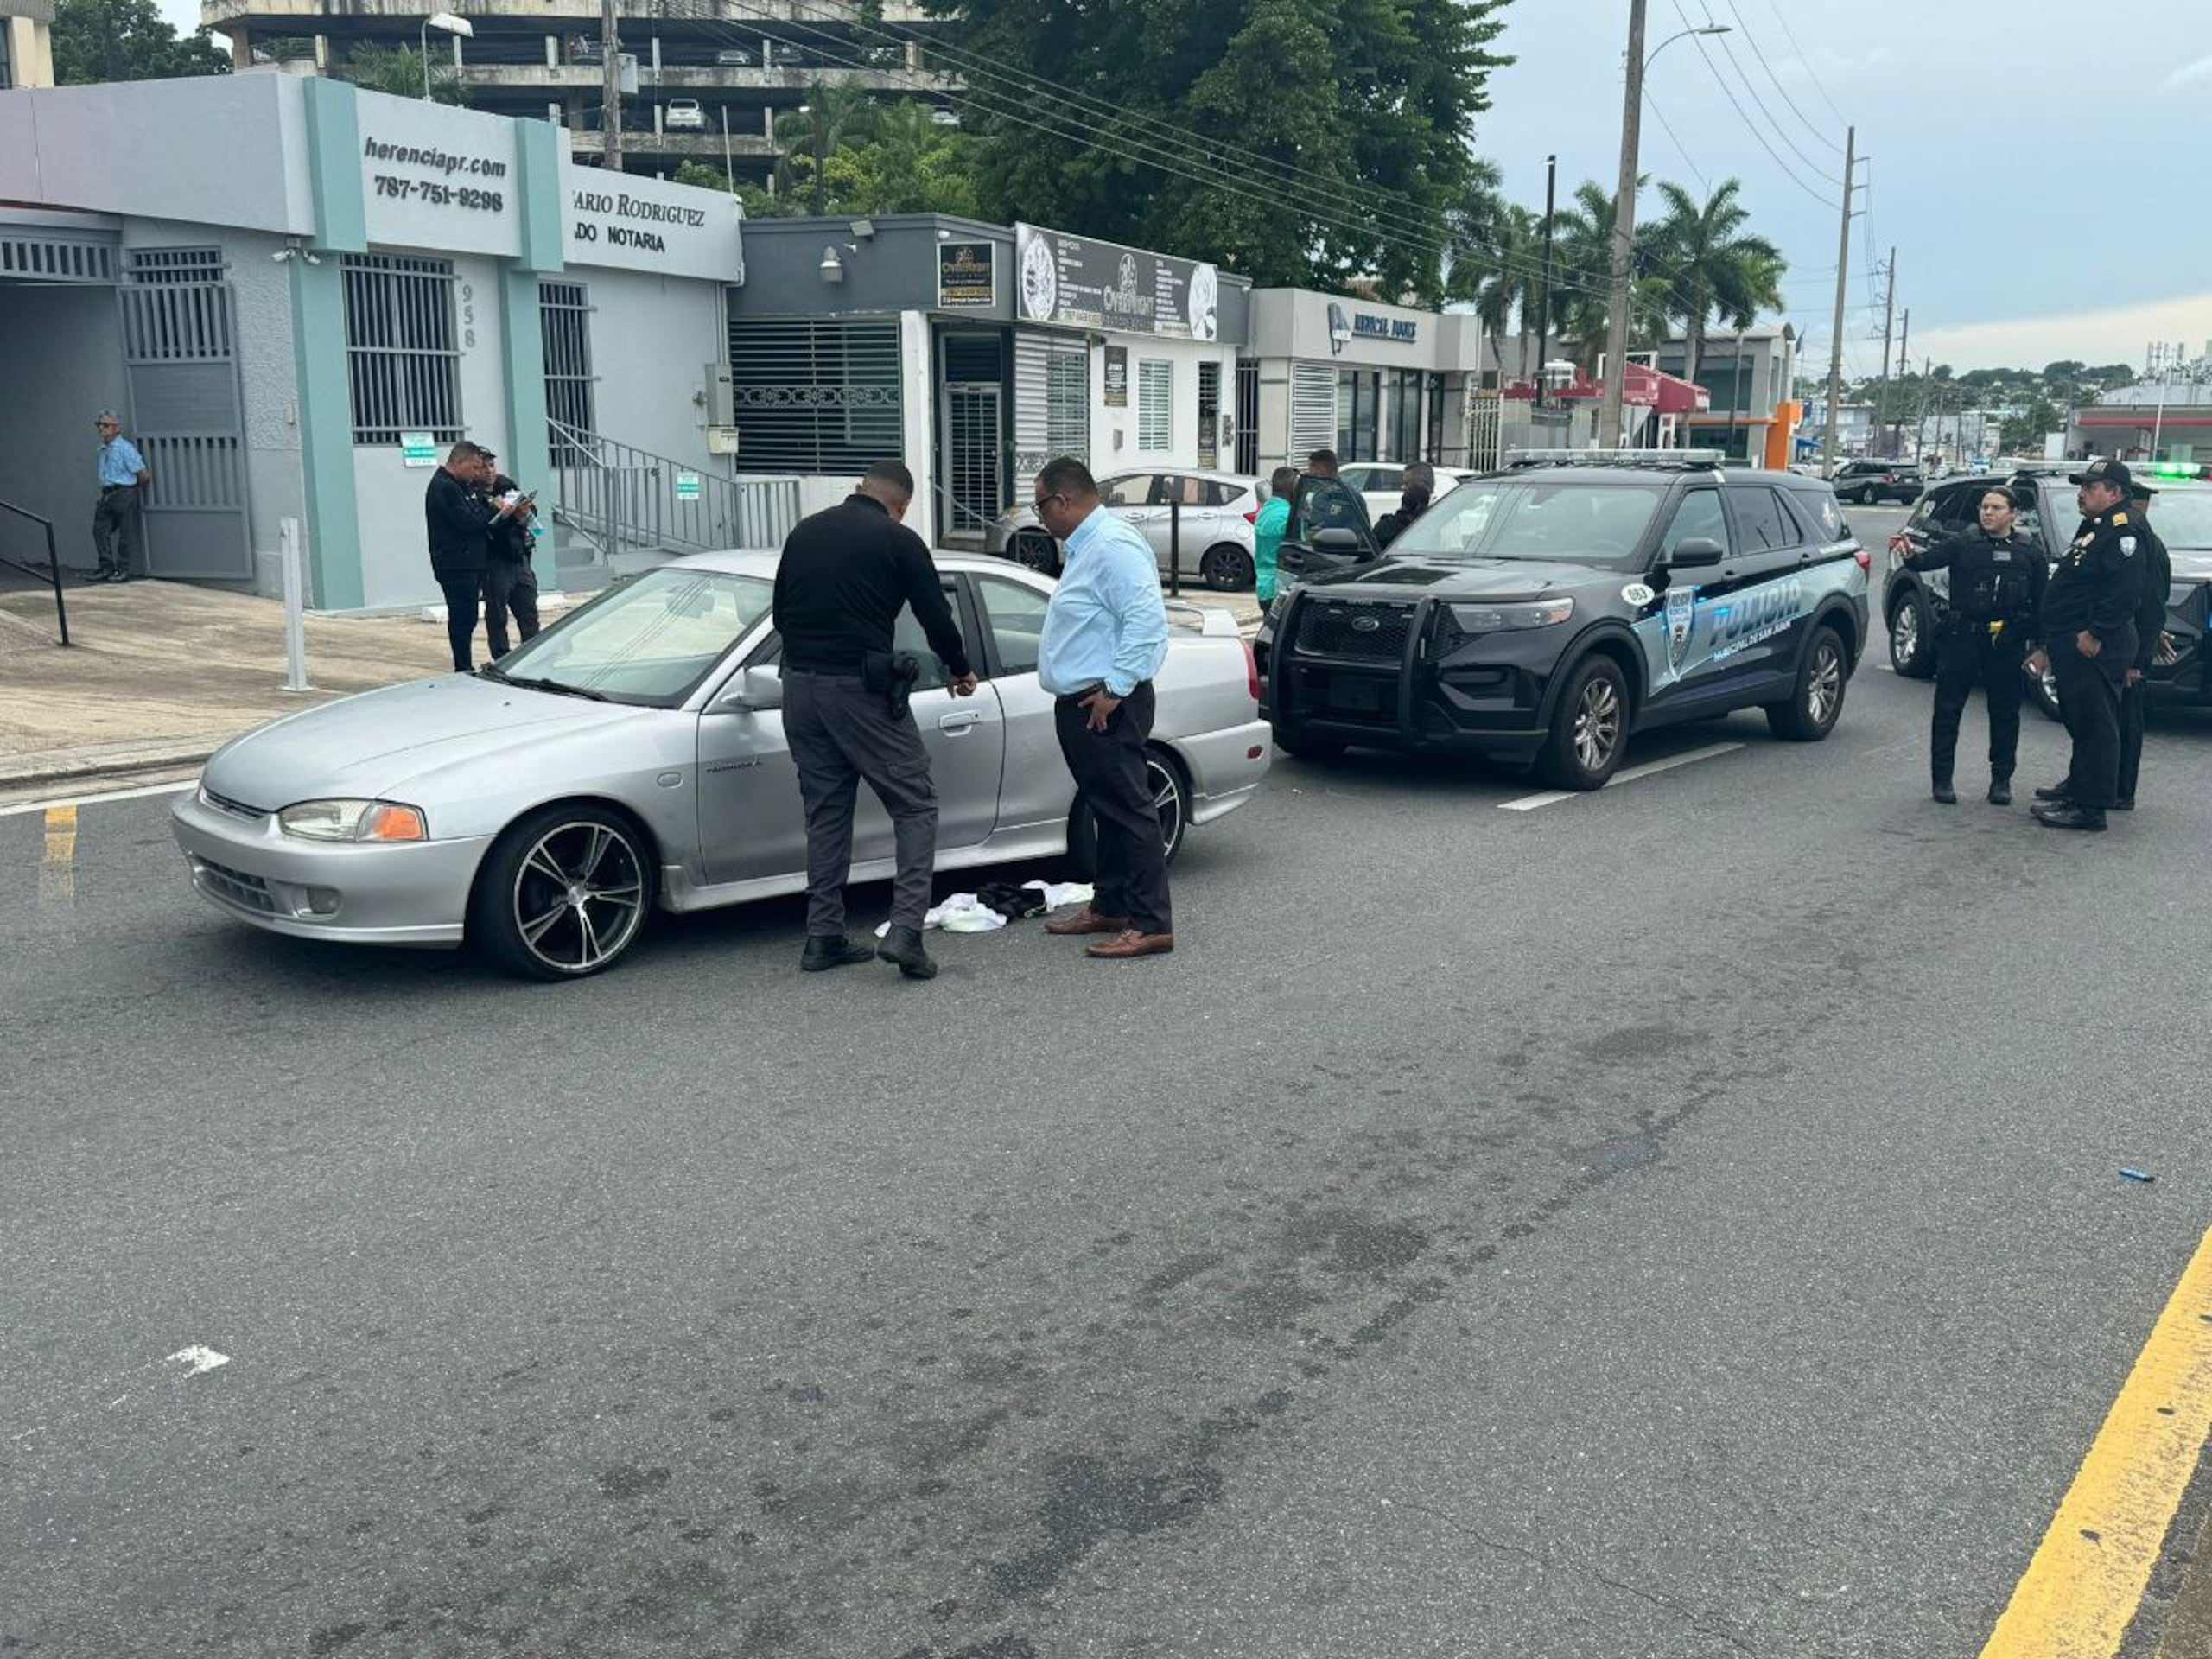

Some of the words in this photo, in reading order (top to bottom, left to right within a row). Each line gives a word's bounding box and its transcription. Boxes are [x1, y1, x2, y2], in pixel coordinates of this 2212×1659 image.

[364, 136, 507, 178] herenciapr.com
[374, 175, 504, 213] 787-751-9298
[573, 190, 613, 213] ARIO
[616, 193, 706, 227] RODRIGUEZ
[607, 226, 666, 253] NOTARIA
[1709, 577, 1802, 647] POLICIA
